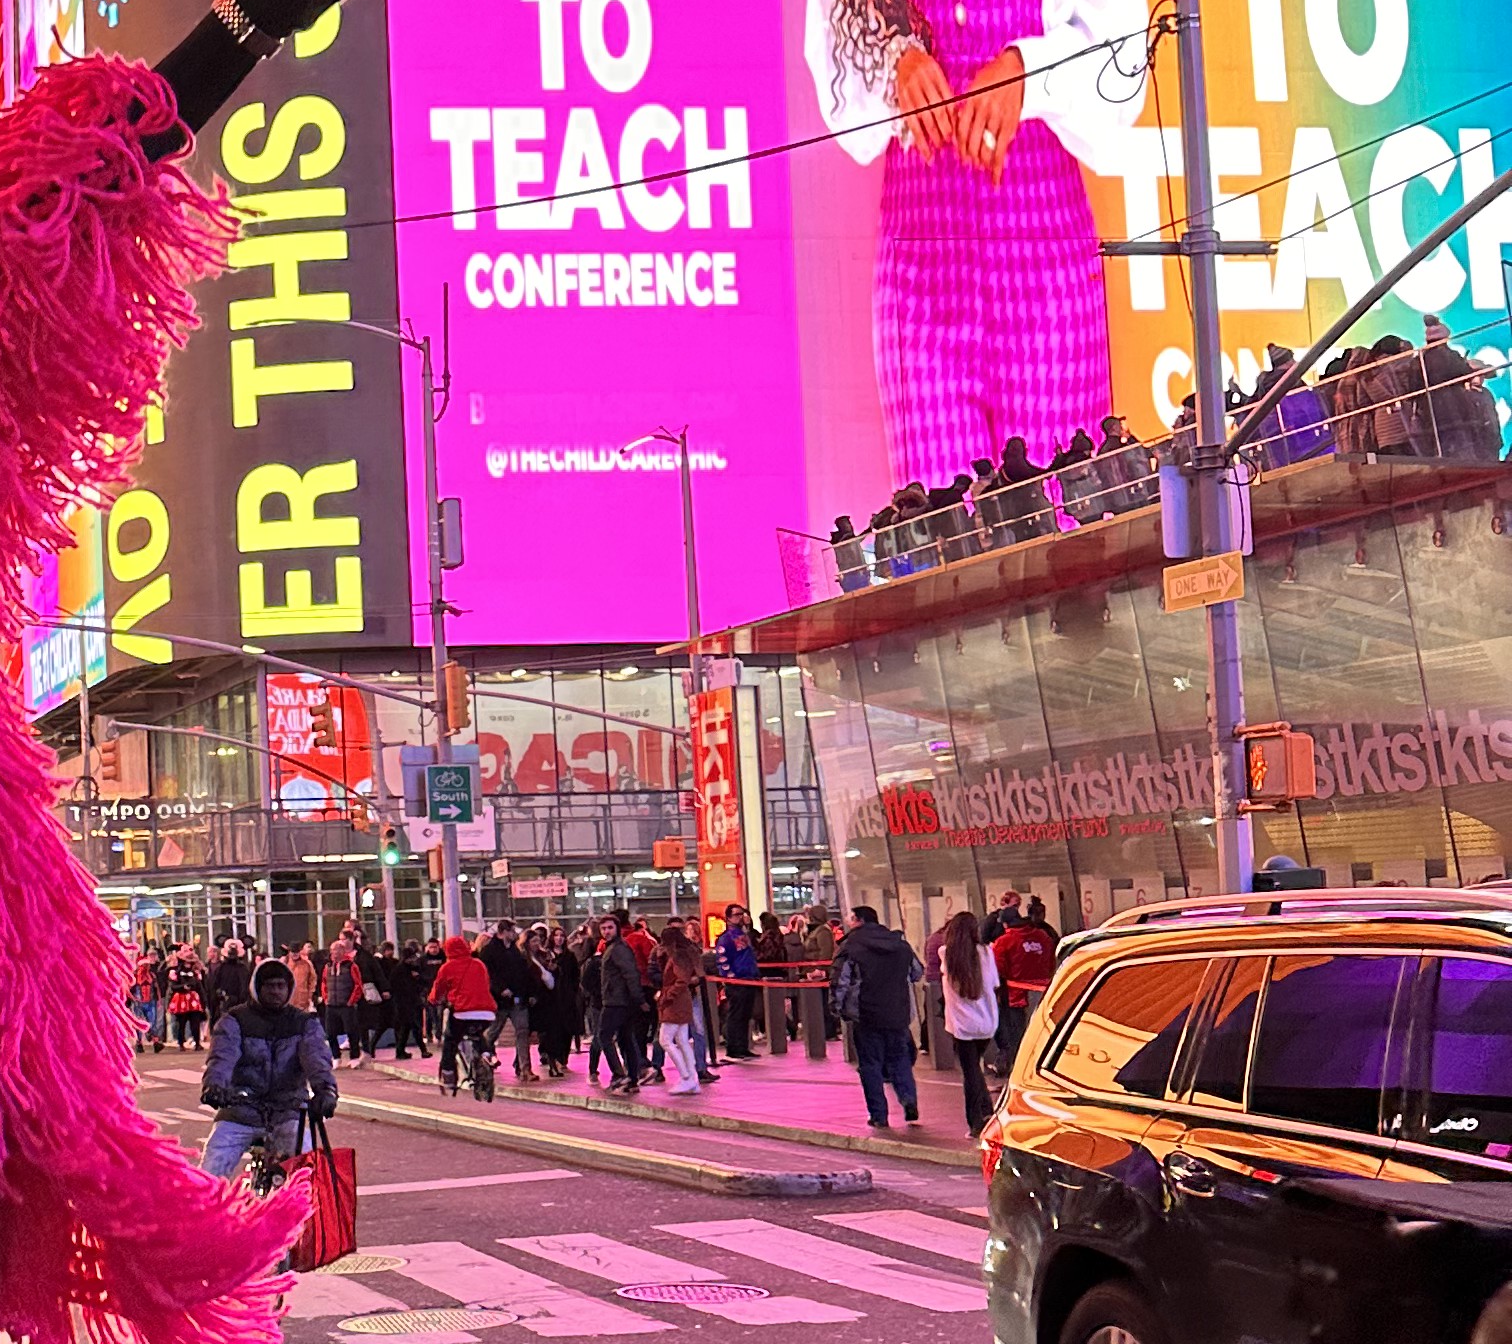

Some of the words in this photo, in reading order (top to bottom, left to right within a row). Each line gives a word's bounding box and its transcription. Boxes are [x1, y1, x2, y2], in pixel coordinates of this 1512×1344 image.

[429, 103, 753, 233] TEACH
[221, 94, 355, 429] THIS
[464, 250, 740, 309] CONFERENCE
[237, 460, 365, 639] ER
[1175, 576, 1197, 596] ONE
[1206, 567, 1230, 589] WAY
[431, 791, 470, 803] South
[883, 782, 941, 837] tkts
